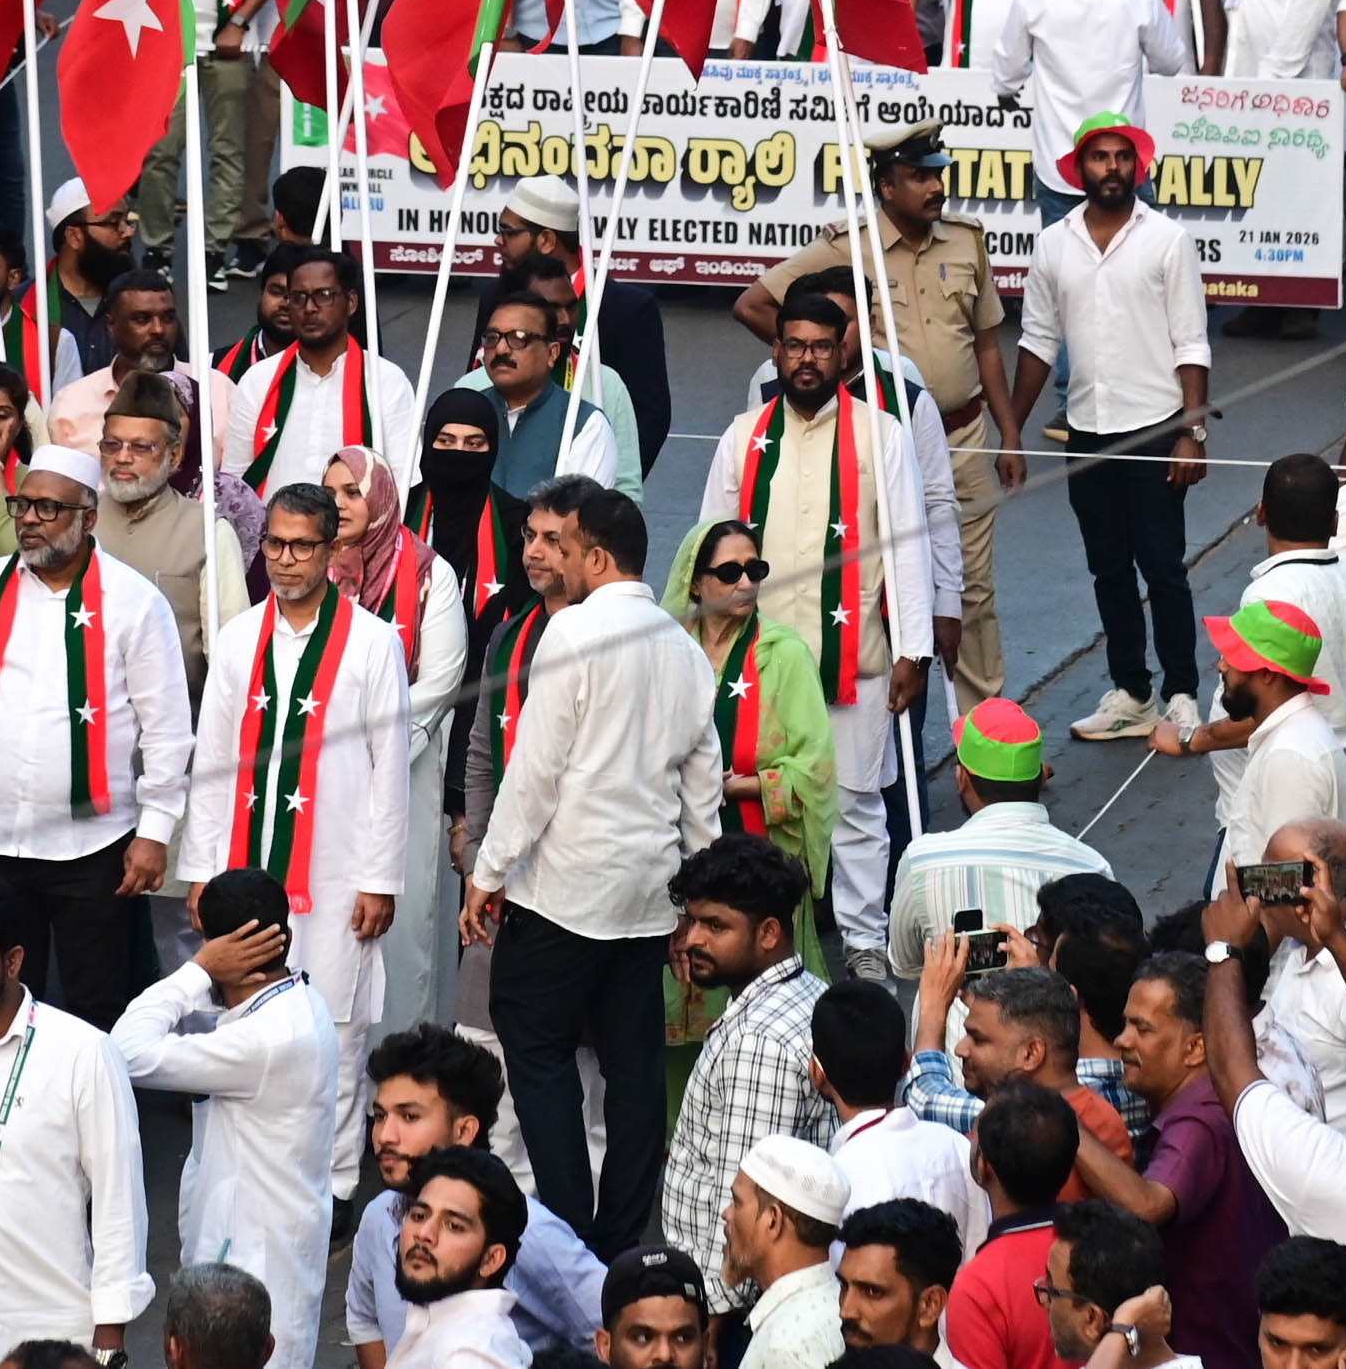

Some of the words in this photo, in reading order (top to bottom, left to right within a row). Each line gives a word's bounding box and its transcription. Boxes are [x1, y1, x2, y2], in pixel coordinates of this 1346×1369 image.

[398, 208, 419, 232] IN
[648, 219, 738, 244] ELECTED
[1259, 231, 1280, 244] JAN
